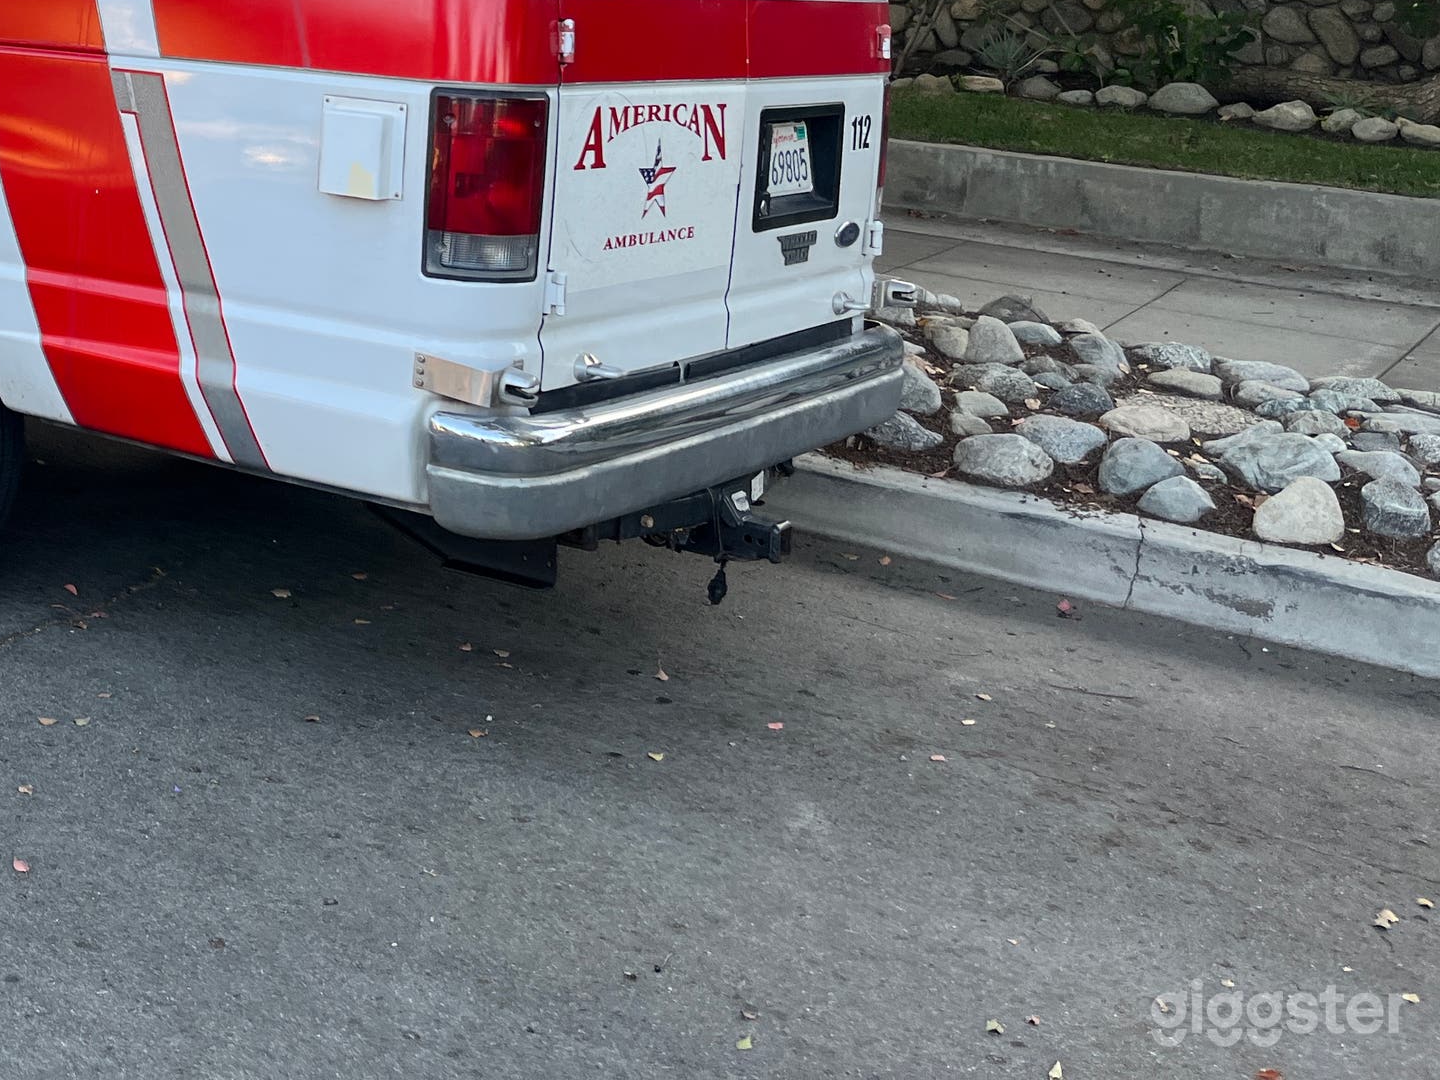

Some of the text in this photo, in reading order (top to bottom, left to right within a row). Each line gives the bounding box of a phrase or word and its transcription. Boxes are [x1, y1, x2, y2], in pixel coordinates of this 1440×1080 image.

[573, 103, 727, 170] AMERICAN
[852, 114, 872, 151] 112
[771, 147, 808, 186] 69805
[603, 226, 695, 251] AMBULANCE
